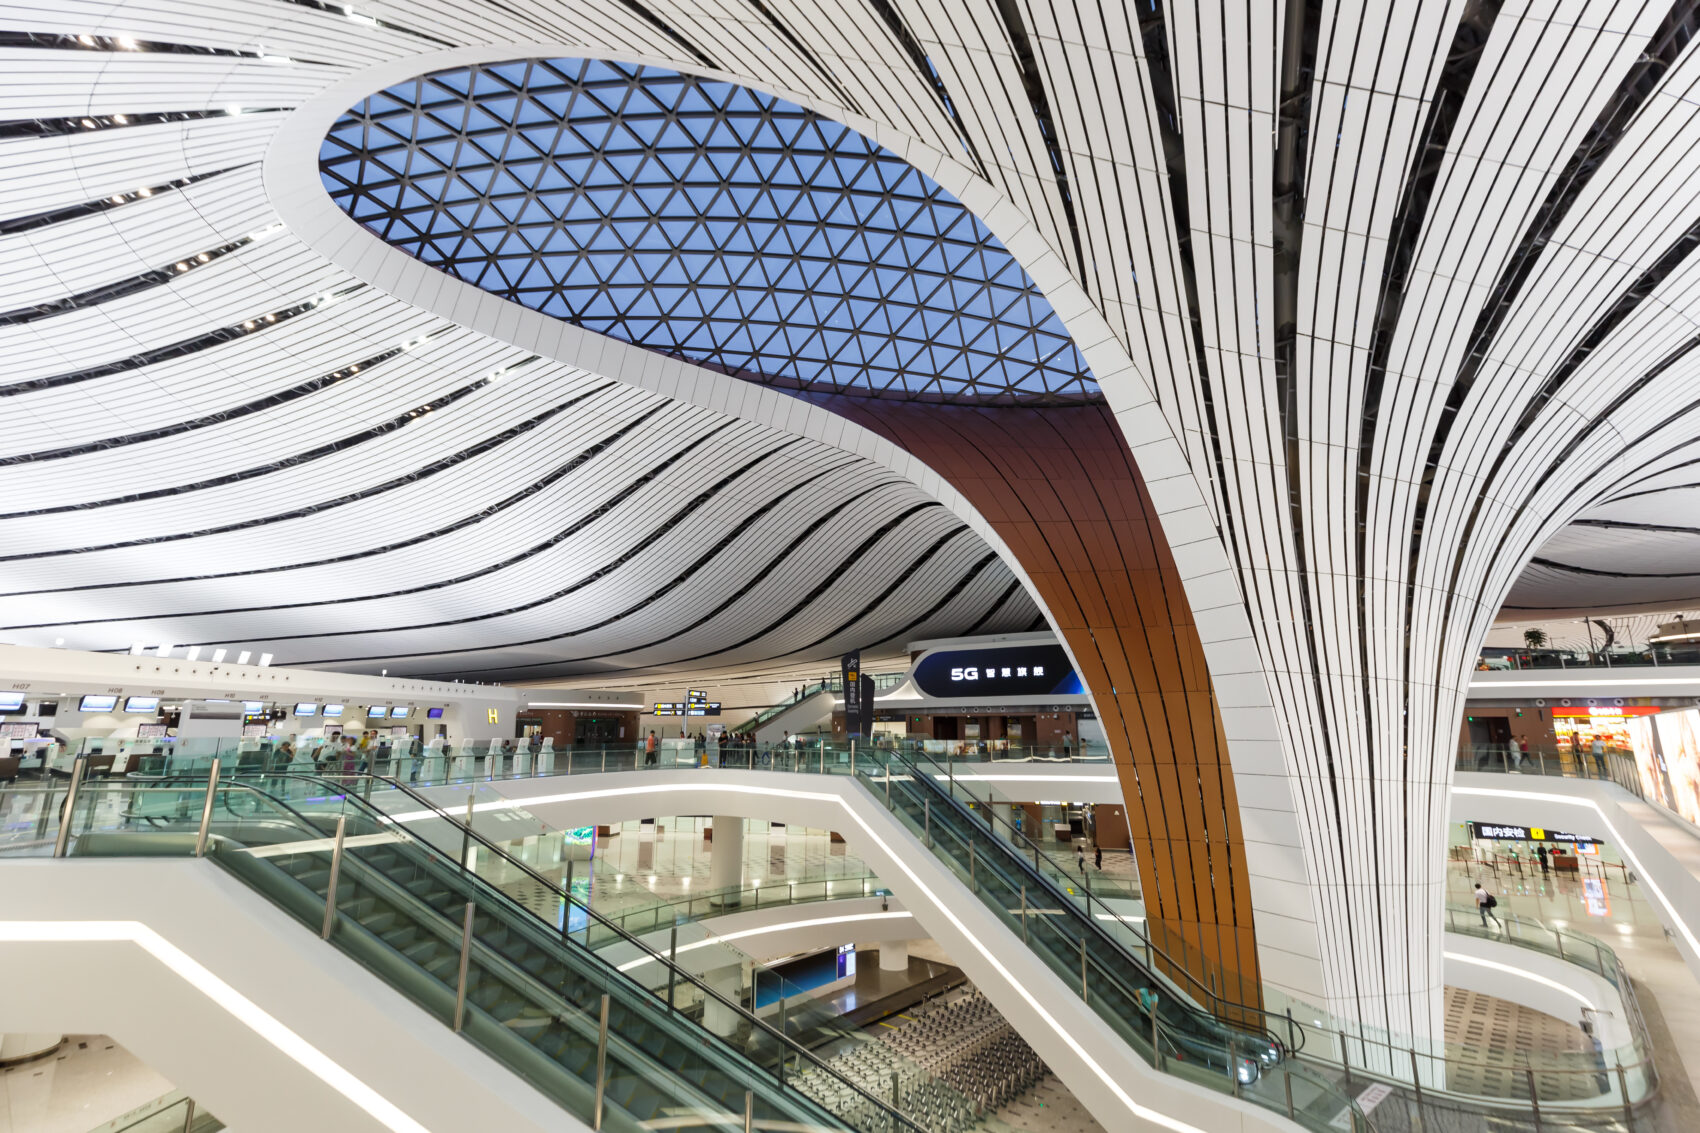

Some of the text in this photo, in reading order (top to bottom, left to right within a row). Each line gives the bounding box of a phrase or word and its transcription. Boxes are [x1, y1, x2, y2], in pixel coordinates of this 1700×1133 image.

[951, 667, 979, 681] 5G
[488, 708, 498, 724] H
[1481, 826, 1525, 838] 国内安检
